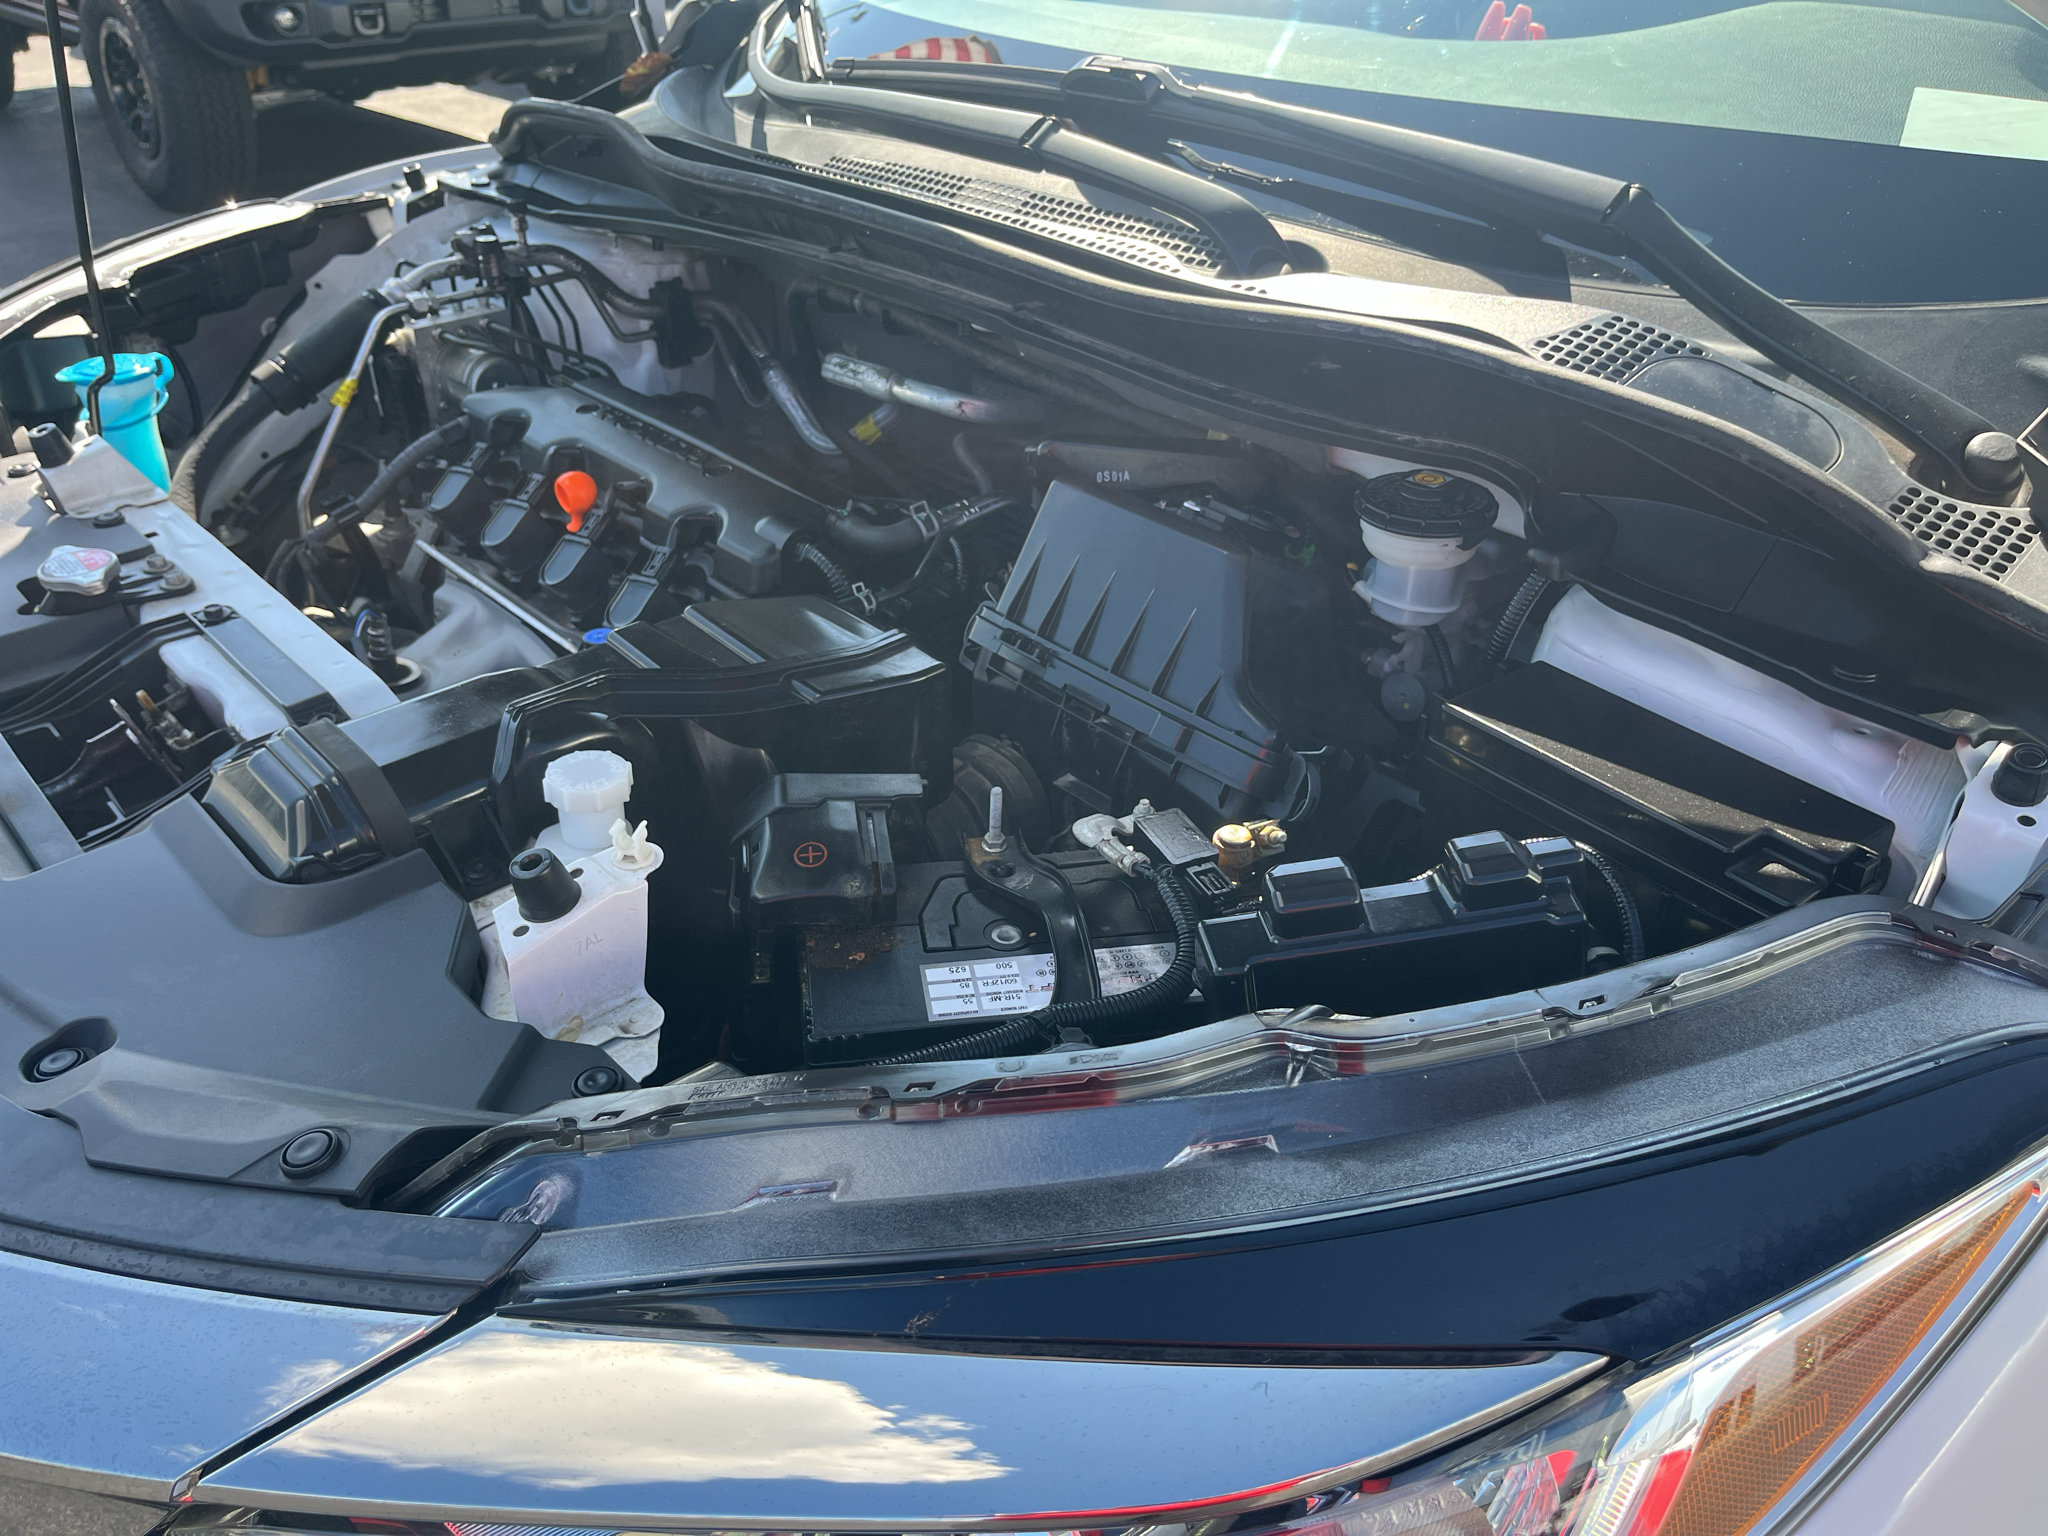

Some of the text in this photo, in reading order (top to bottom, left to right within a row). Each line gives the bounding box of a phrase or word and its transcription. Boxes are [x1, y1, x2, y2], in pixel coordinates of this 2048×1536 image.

[948, 966, 966, 974] 625
[982, 978, 1017, 986] 60/12FR
[988, 993, 1021, 1003] 51R-MF
